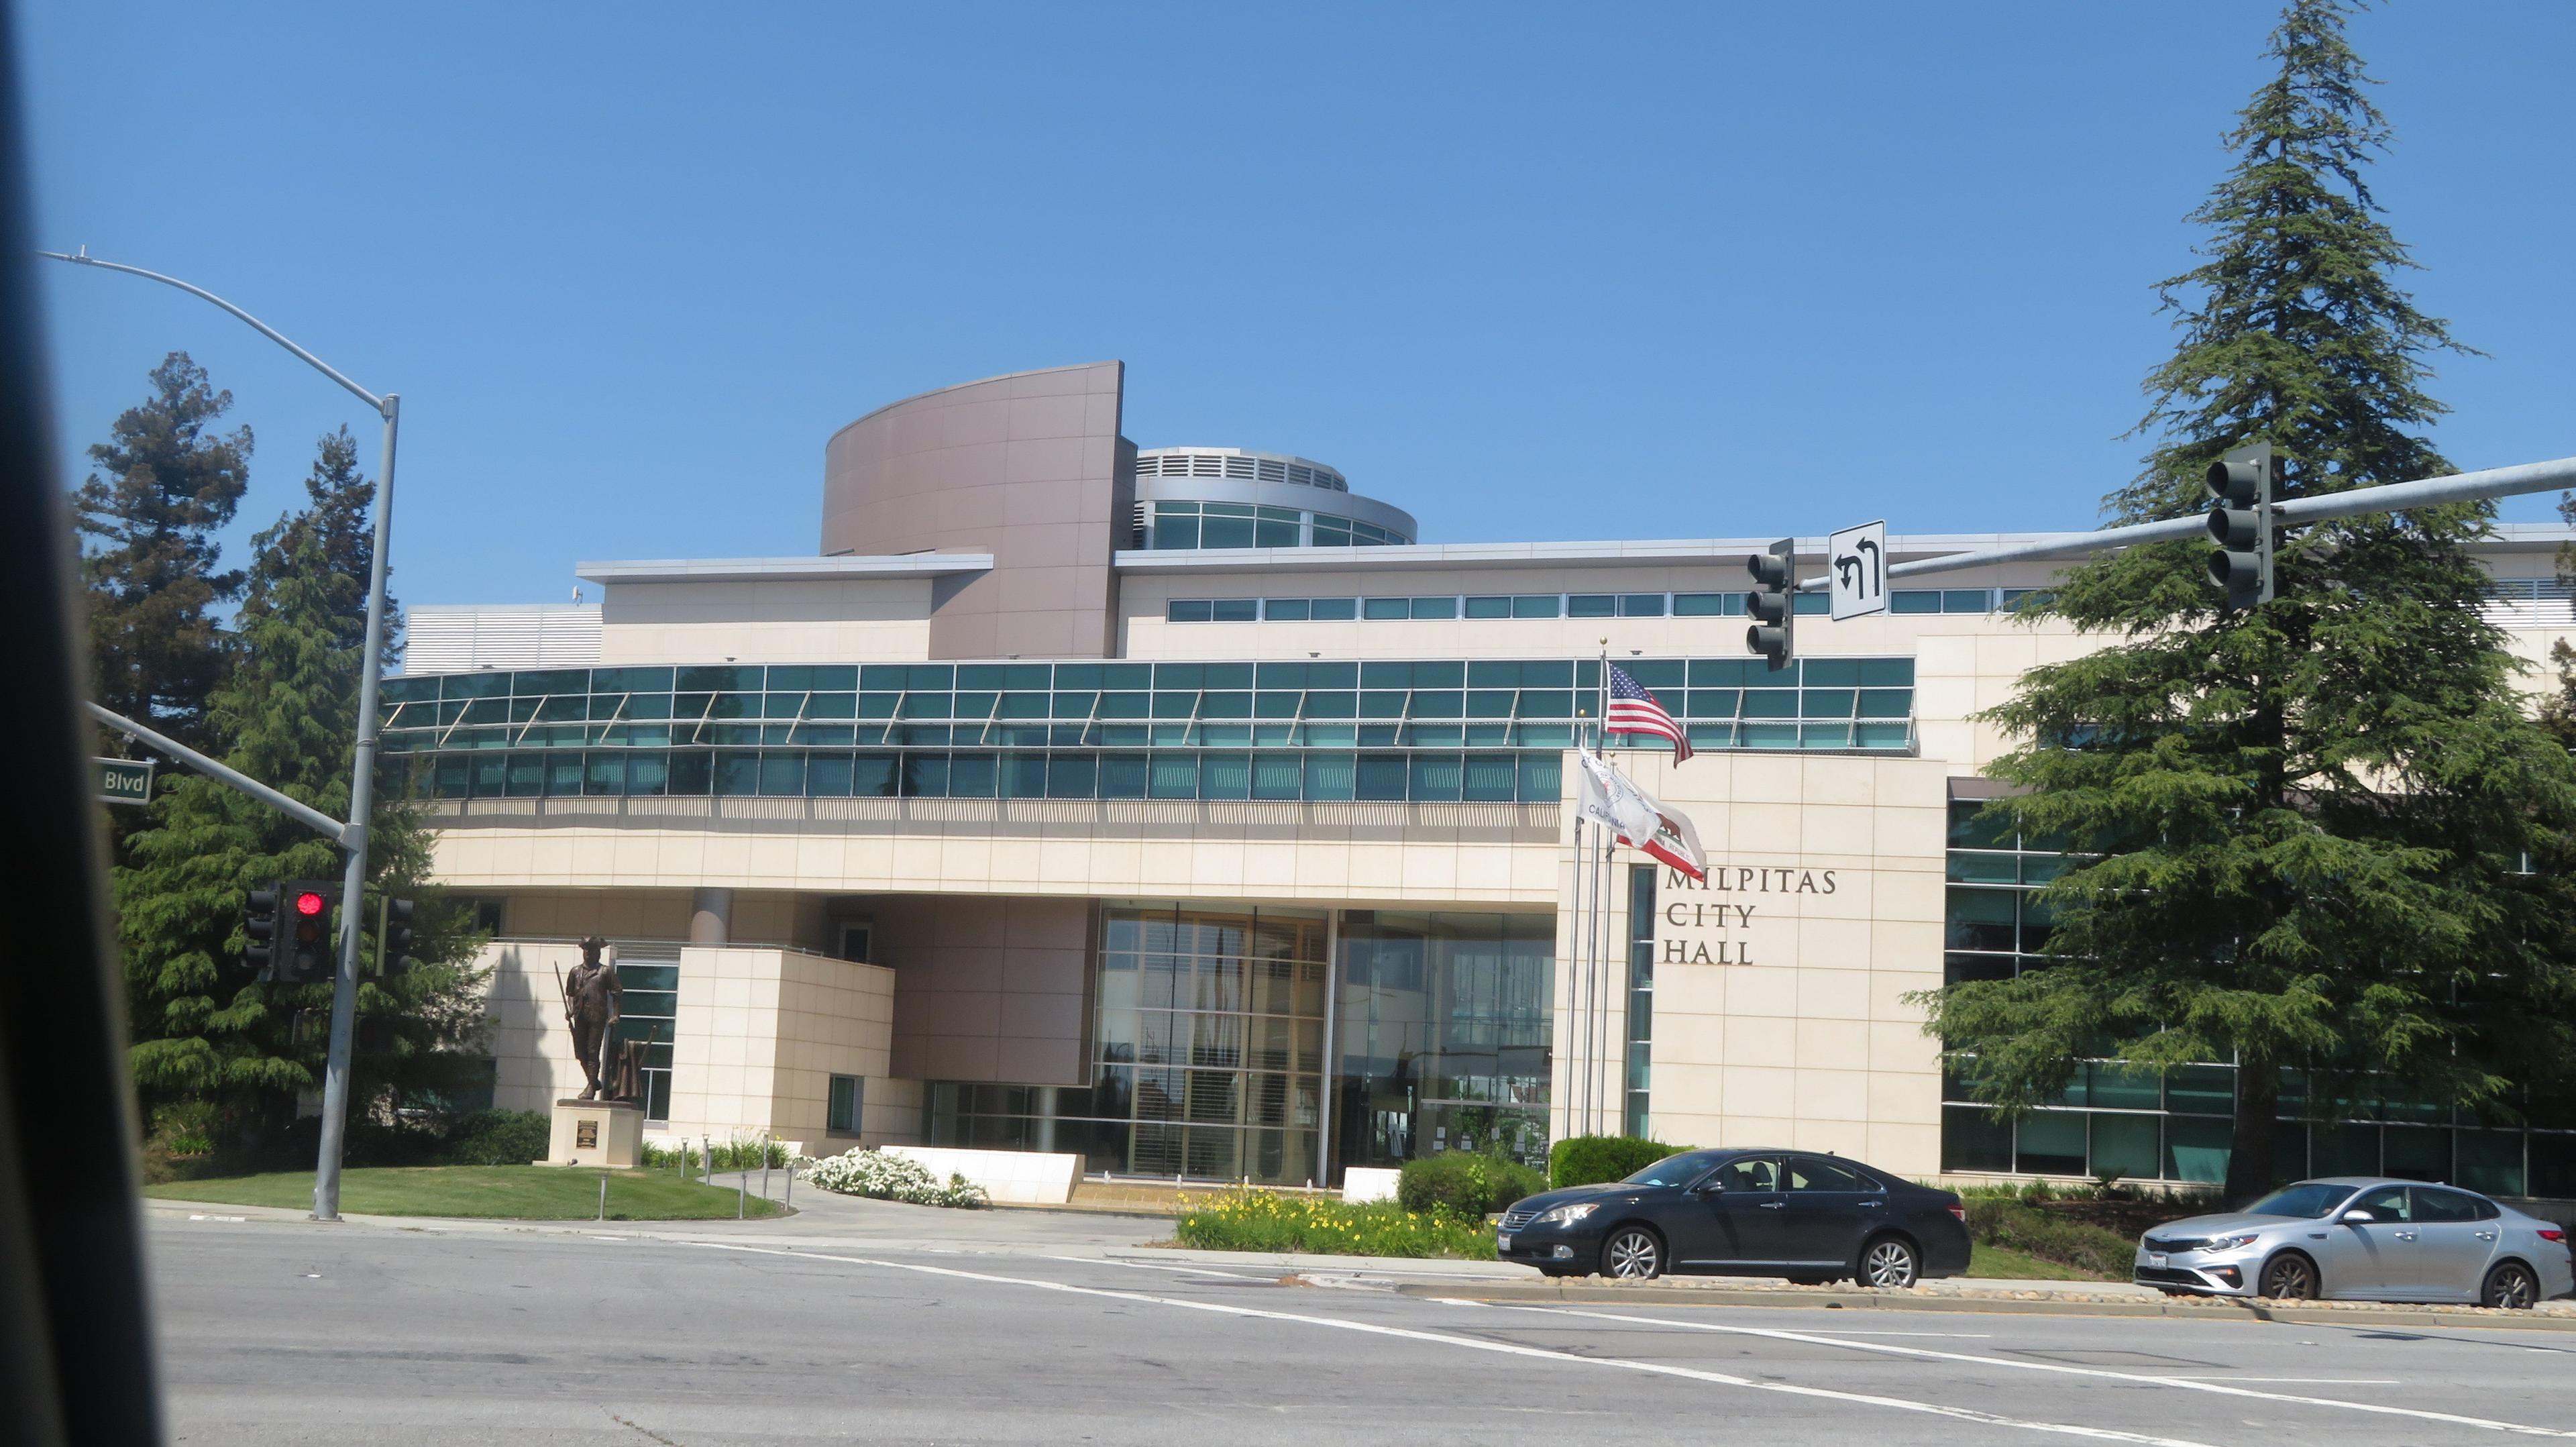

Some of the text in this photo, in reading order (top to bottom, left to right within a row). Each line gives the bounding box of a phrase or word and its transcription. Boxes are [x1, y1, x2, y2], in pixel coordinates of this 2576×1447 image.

[105, 771, 144, 792] Blvd
[1589, 804, 1626, 830] CALIFNIA
[1665, 867, 1836, 895] MILPITAS
[1666, 902, 1756, 928] CITY
[1663, 939, 1754, 965] HALL
